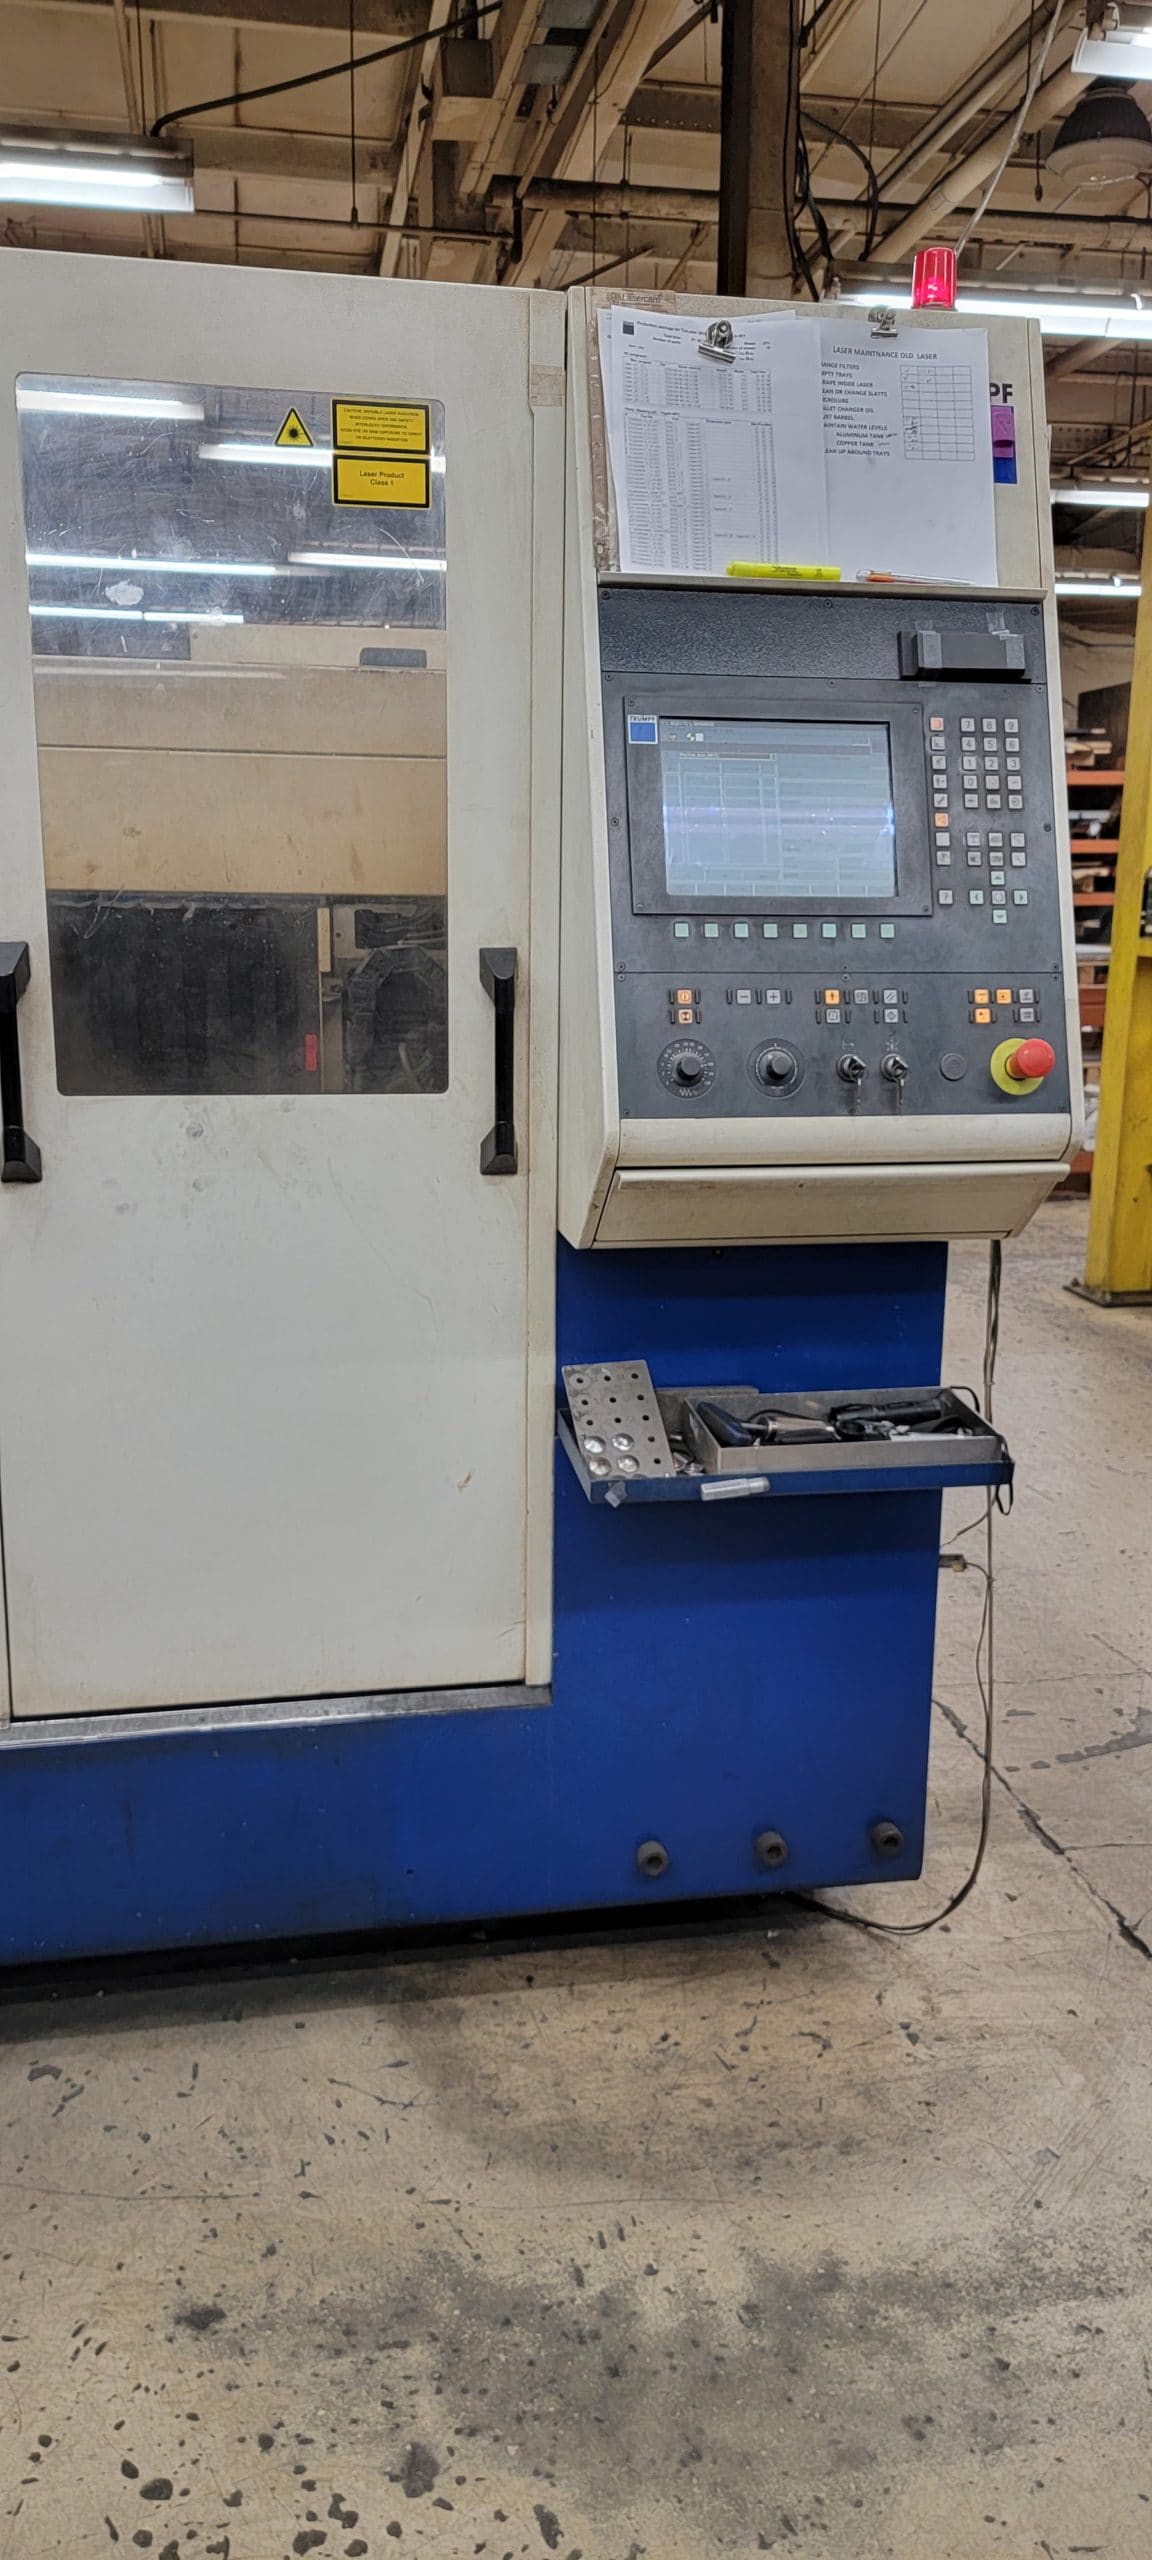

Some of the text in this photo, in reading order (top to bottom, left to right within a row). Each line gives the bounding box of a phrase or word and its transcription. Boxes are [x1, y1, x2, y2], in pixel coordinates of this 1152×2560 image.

[833, 346, 853, 355] LASER
[854, 347, 898, 359] MAINTNANCE
[917, 352, 937, 360] LASER
[839, 363, 860, 371] FILTERS
[989, 382, 1013, 404] PF
[836, 431, 868, 439] ALUMINUM
[360, 470, 405, 479] Laser Product
[370, 478, 388, 486] Class
